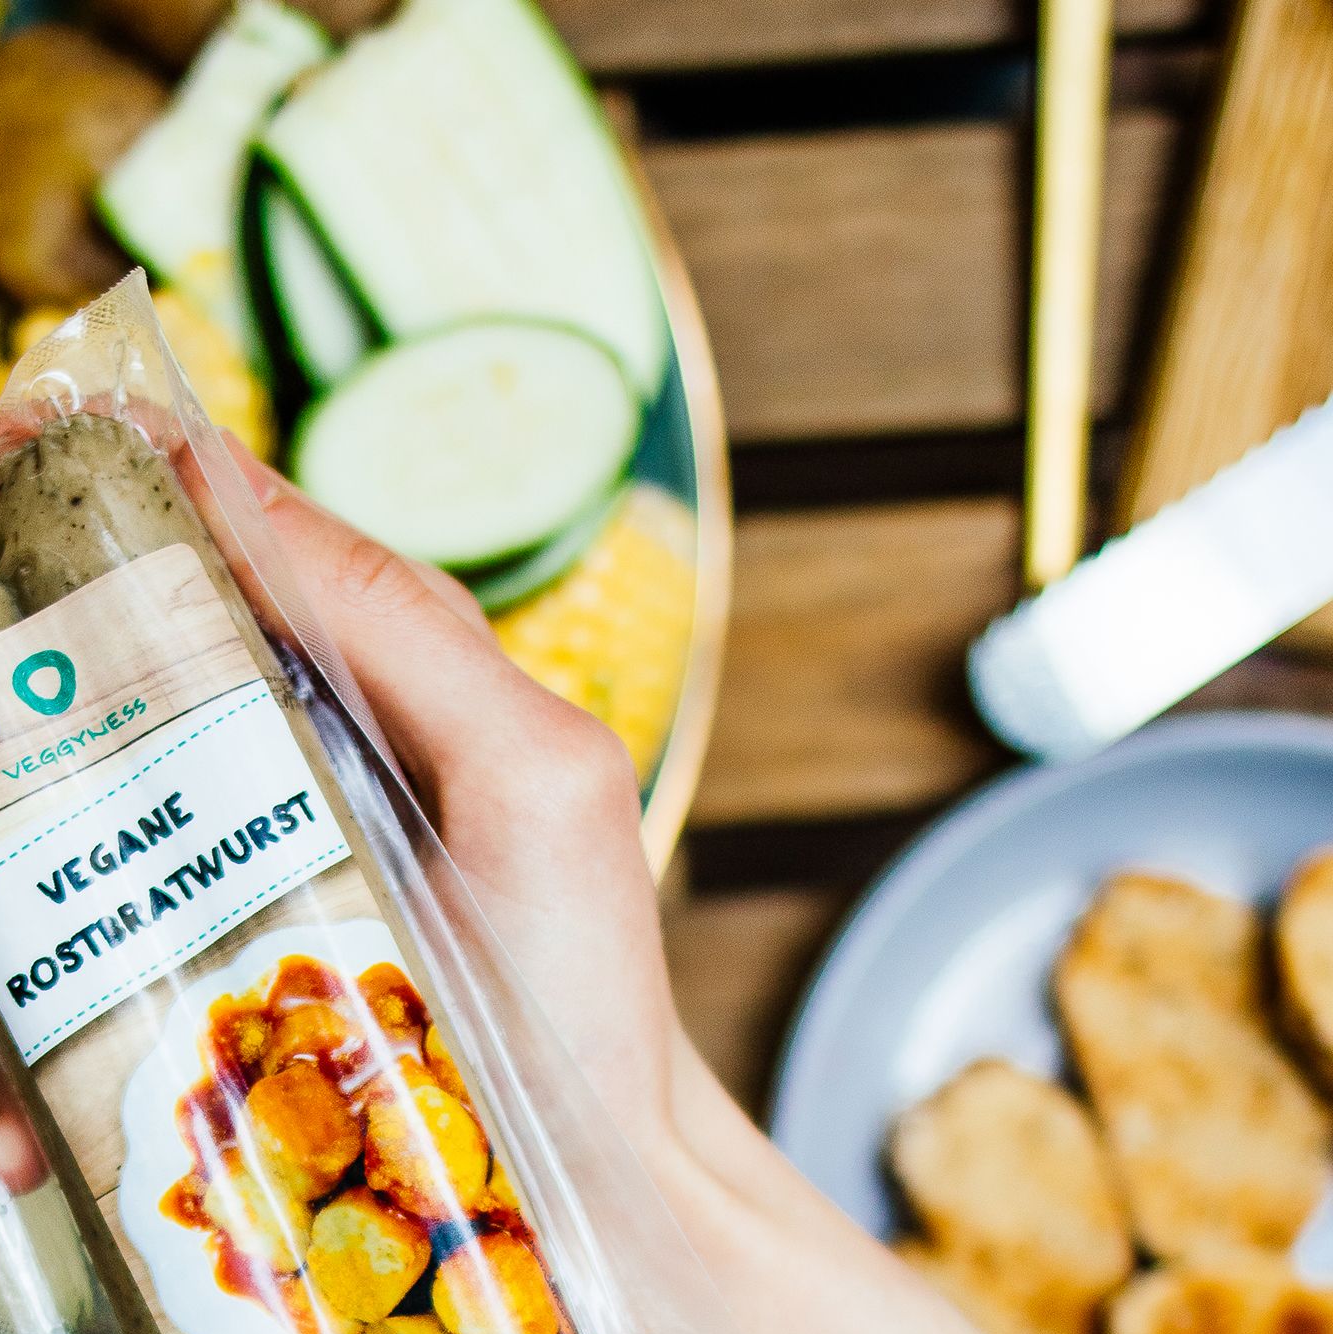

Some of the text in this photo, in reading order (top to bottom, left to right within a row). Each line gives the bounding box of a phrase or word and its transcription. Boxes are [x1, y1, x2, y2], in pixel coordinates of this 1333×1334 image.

[1, 698, 147, 779] VEGGYNESS
[5, 790, 316, 1008] ROSTBRATWURST
[36, 791, 195, 904] VEGANE
